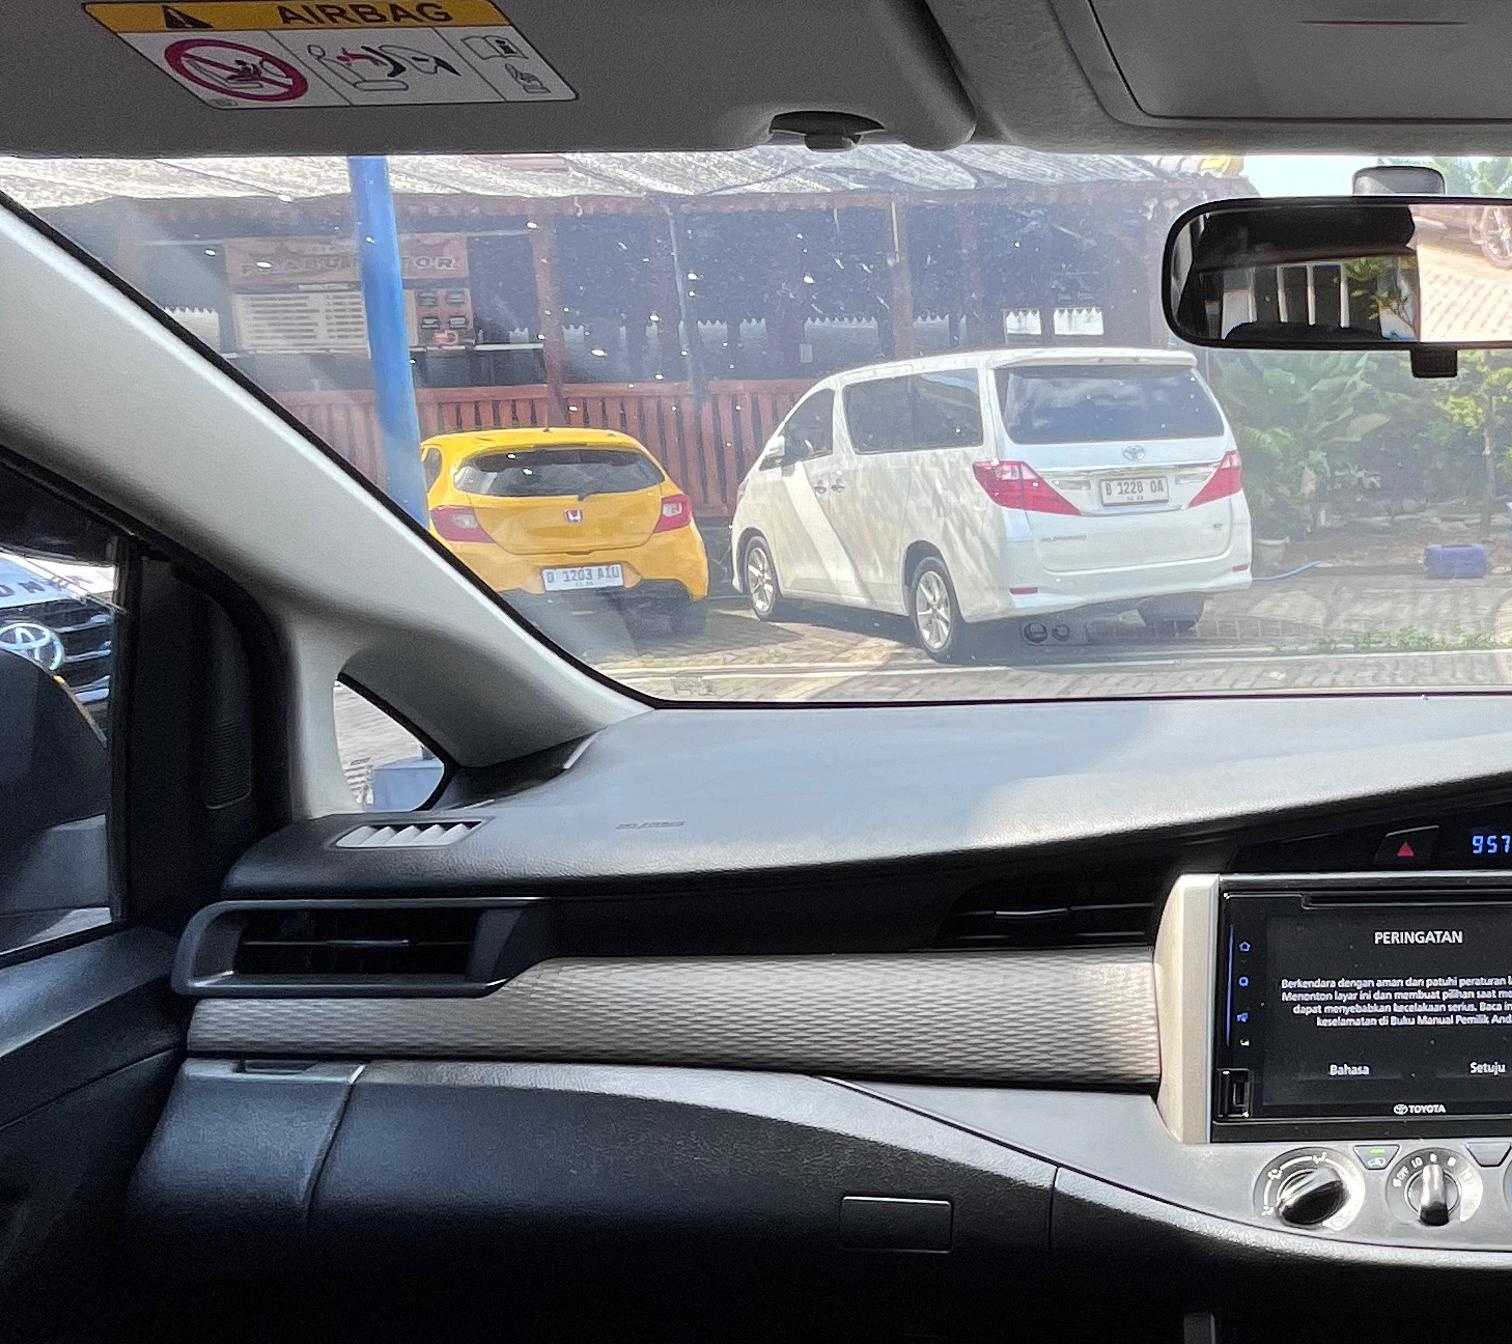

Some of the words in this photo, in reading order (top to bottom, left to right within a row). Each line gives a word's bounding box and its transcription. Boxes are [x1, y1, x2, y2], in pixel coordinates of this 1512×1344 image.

[277, 3, 453, 25] AIRBAG
[1105, 483, 1113, 496] B
[1117, 481, 1144, 495] 1228
[1374, 930, 1463, 945] PERINGATAN
[1281, 978, 1336, 989] Berkendara
[1338, 978, 1375, 991] dengan
[1376, 979, 1404, 987] aman
[1405, 977, 1424, 987] dan
[1426, 976, 1458, 990] patuhi
[1459, 977, 1506, 990] peraturan
[1281, 991, 1333, 1002] Menonton
[1334, 991, 1358, 1004] layar
[1360, 990, 1371, 1001] ini
[1373, 990, 1392, 1001] dan
[1394, 990, 1441, 1001] membuat
[1442, 989, 1475, 1002] pilihan
[1476, 989, 1496, 1000] saat
[1293, 1004, 1322, 1017] dapat
[1324, 1003, 1391, 1016] menyebabkan
[1393, 1002, 1446, 1014] kecelakaan
[1479, 1002, 1502, 1012] Baca
[1316, 1016, 1377, 1027] keselamatan
[1378, 1015, 1389, 1026] di
[1391, 1015, 1415, 1026] Buku
[1417, 1014, 1453, 1026] Manual
[1455, 1014, 1489, 1025] Pemilik
[1329, 1063, 1370, 1076] Bahasa
[1470, 1061, 1506, 1075] Setuju
[1408, 1105, 1446, 1114] TOYOTA
